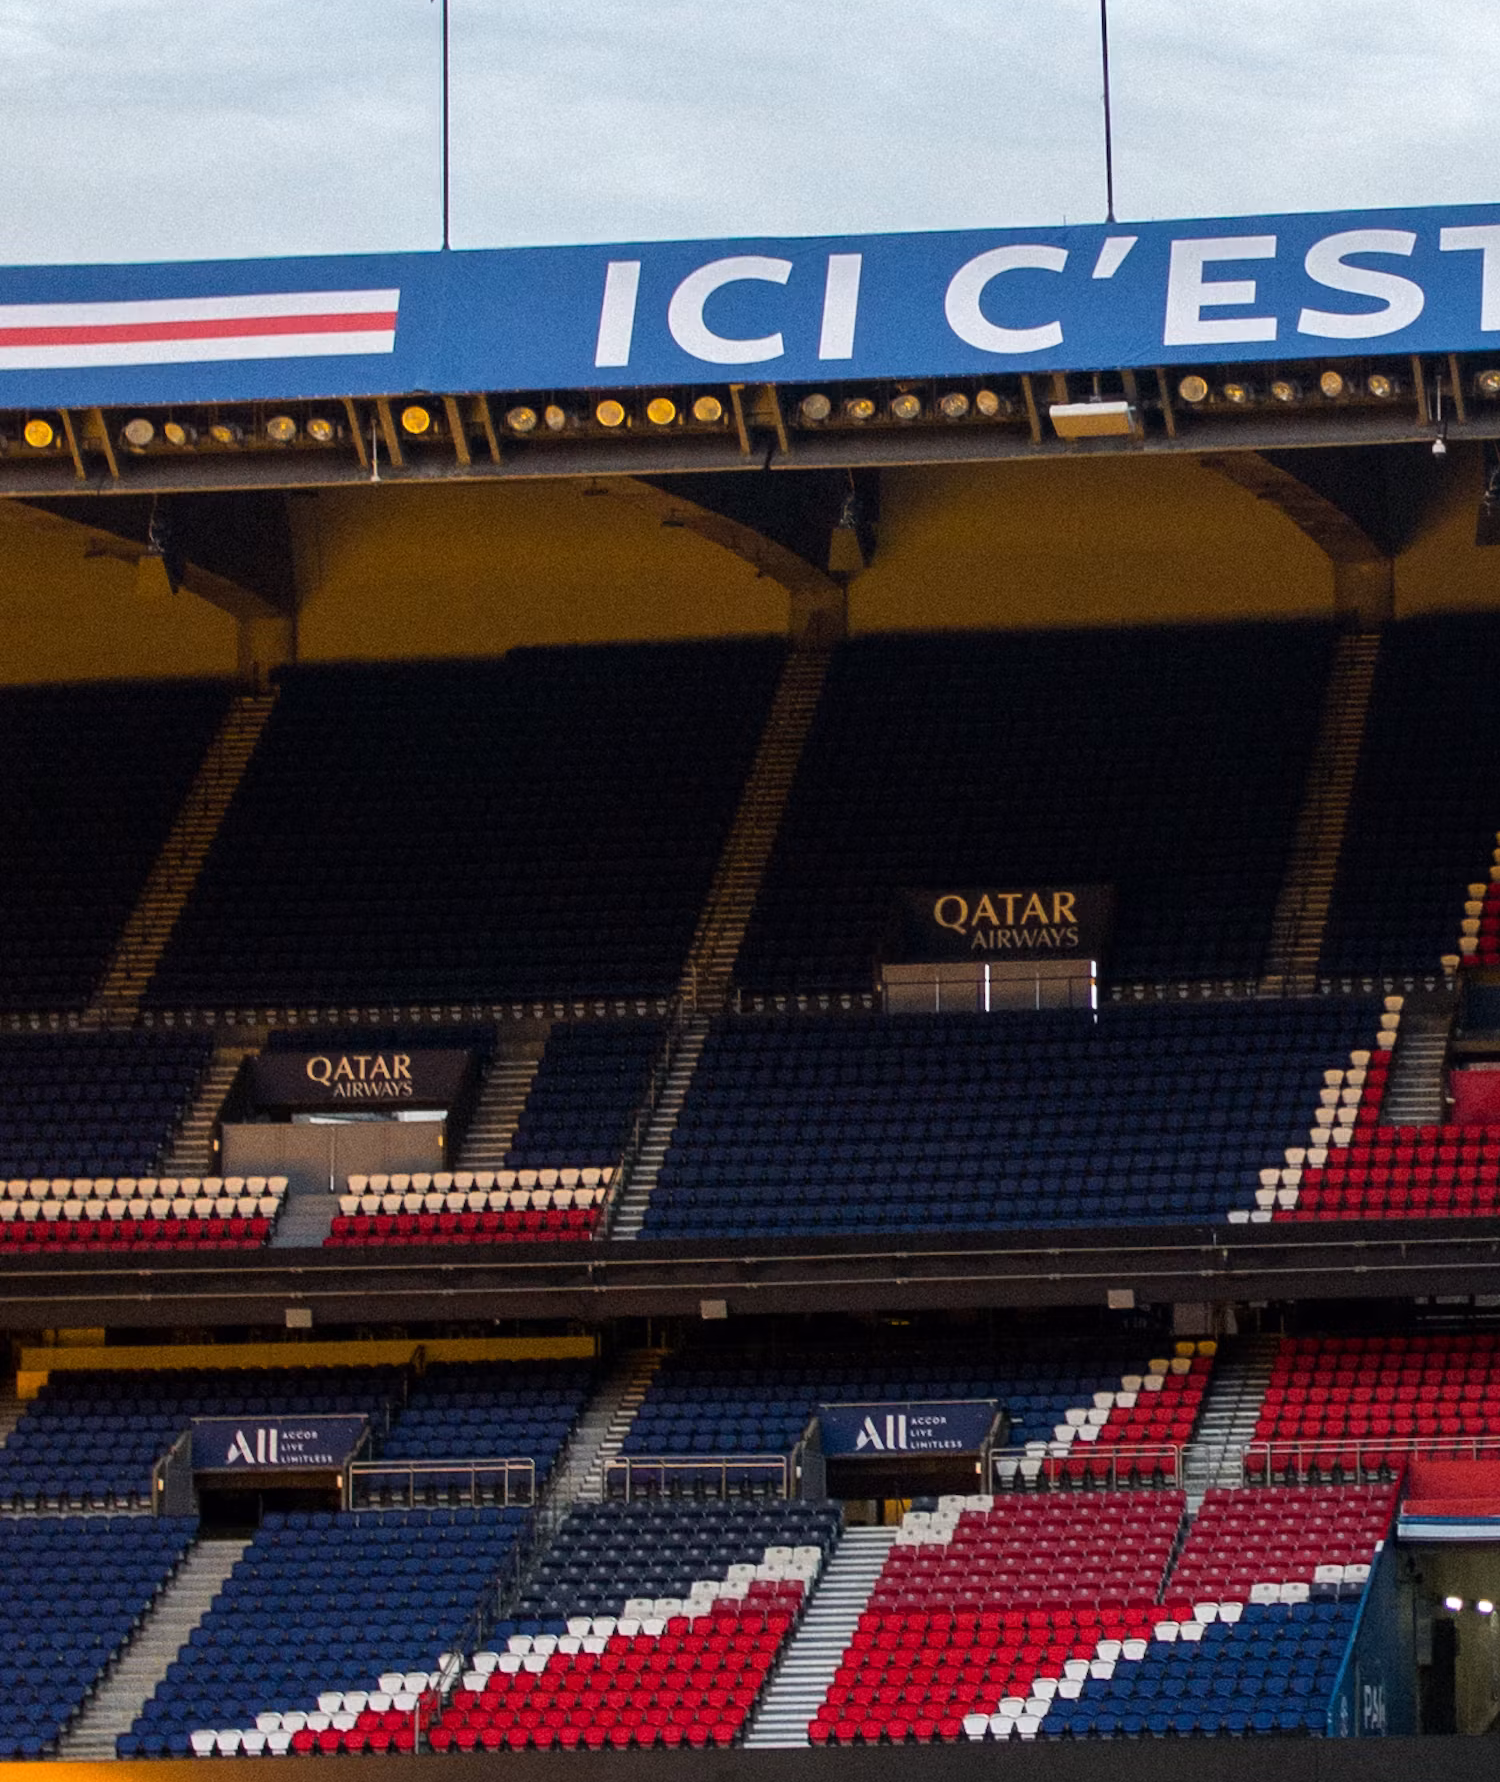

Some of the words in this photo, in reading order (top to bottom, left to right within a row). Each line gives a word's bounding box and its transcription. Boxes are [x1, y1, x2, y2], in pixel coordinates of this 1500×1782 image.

[595, 254, 861, 367] ICI
[934, 891, 1077, 933] QATAR
[971, 927, 1078, 948] AIRWAYS
[307, 1054, 412, 1085] QATAR
[334, 1081, 413, 1097] AIRWAYS
[911, 1416, 947, 1425] ACCOR
[910, 1428, 933, 1437] LIVE
[910, 1440, 962, 1449] LIMITLESS
